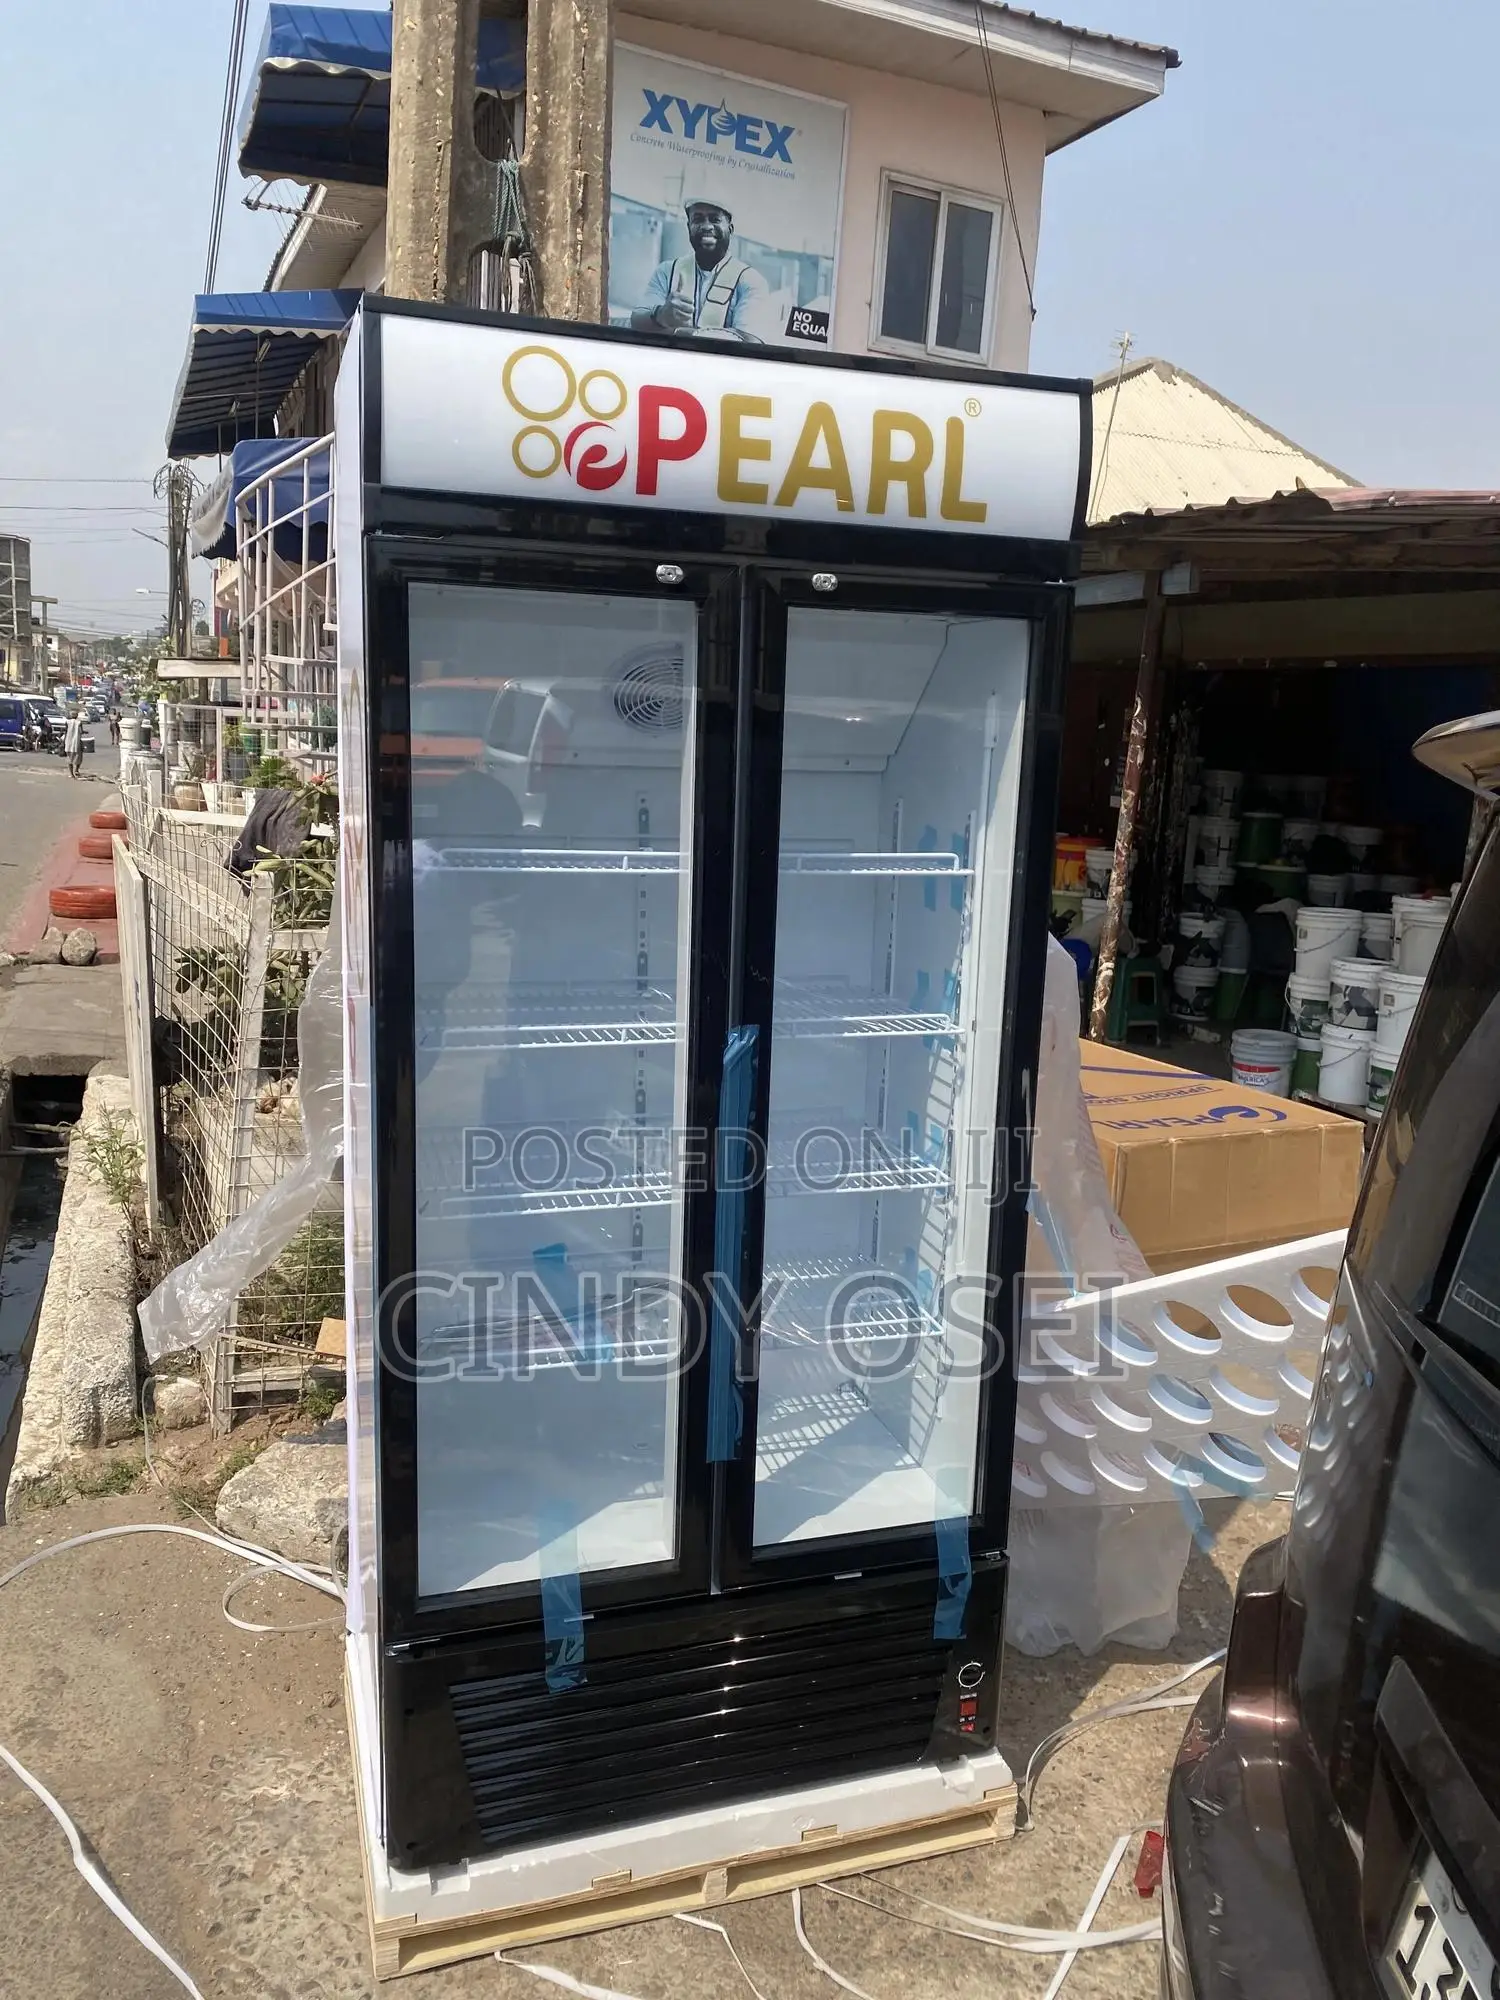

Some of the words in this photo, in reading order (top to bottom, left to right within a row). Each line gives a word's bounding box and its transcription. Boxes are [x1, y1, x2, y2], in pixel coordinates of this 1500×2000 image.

[639, 88, 796, 164] XYPEX
[630, 132, 665, 149] Concrete
[667, 141, 726, 165] Waterproofing
[727, 153, 738, 169] by
[792, 321, 828, 337] EQUA
[793, 310, 812, 323] NO
[635, 384, 988, 523] PEARL
[1132, 1085, 1214, 1101] UPRIGHT
[1395, 1904, 1480, 2000] 13
